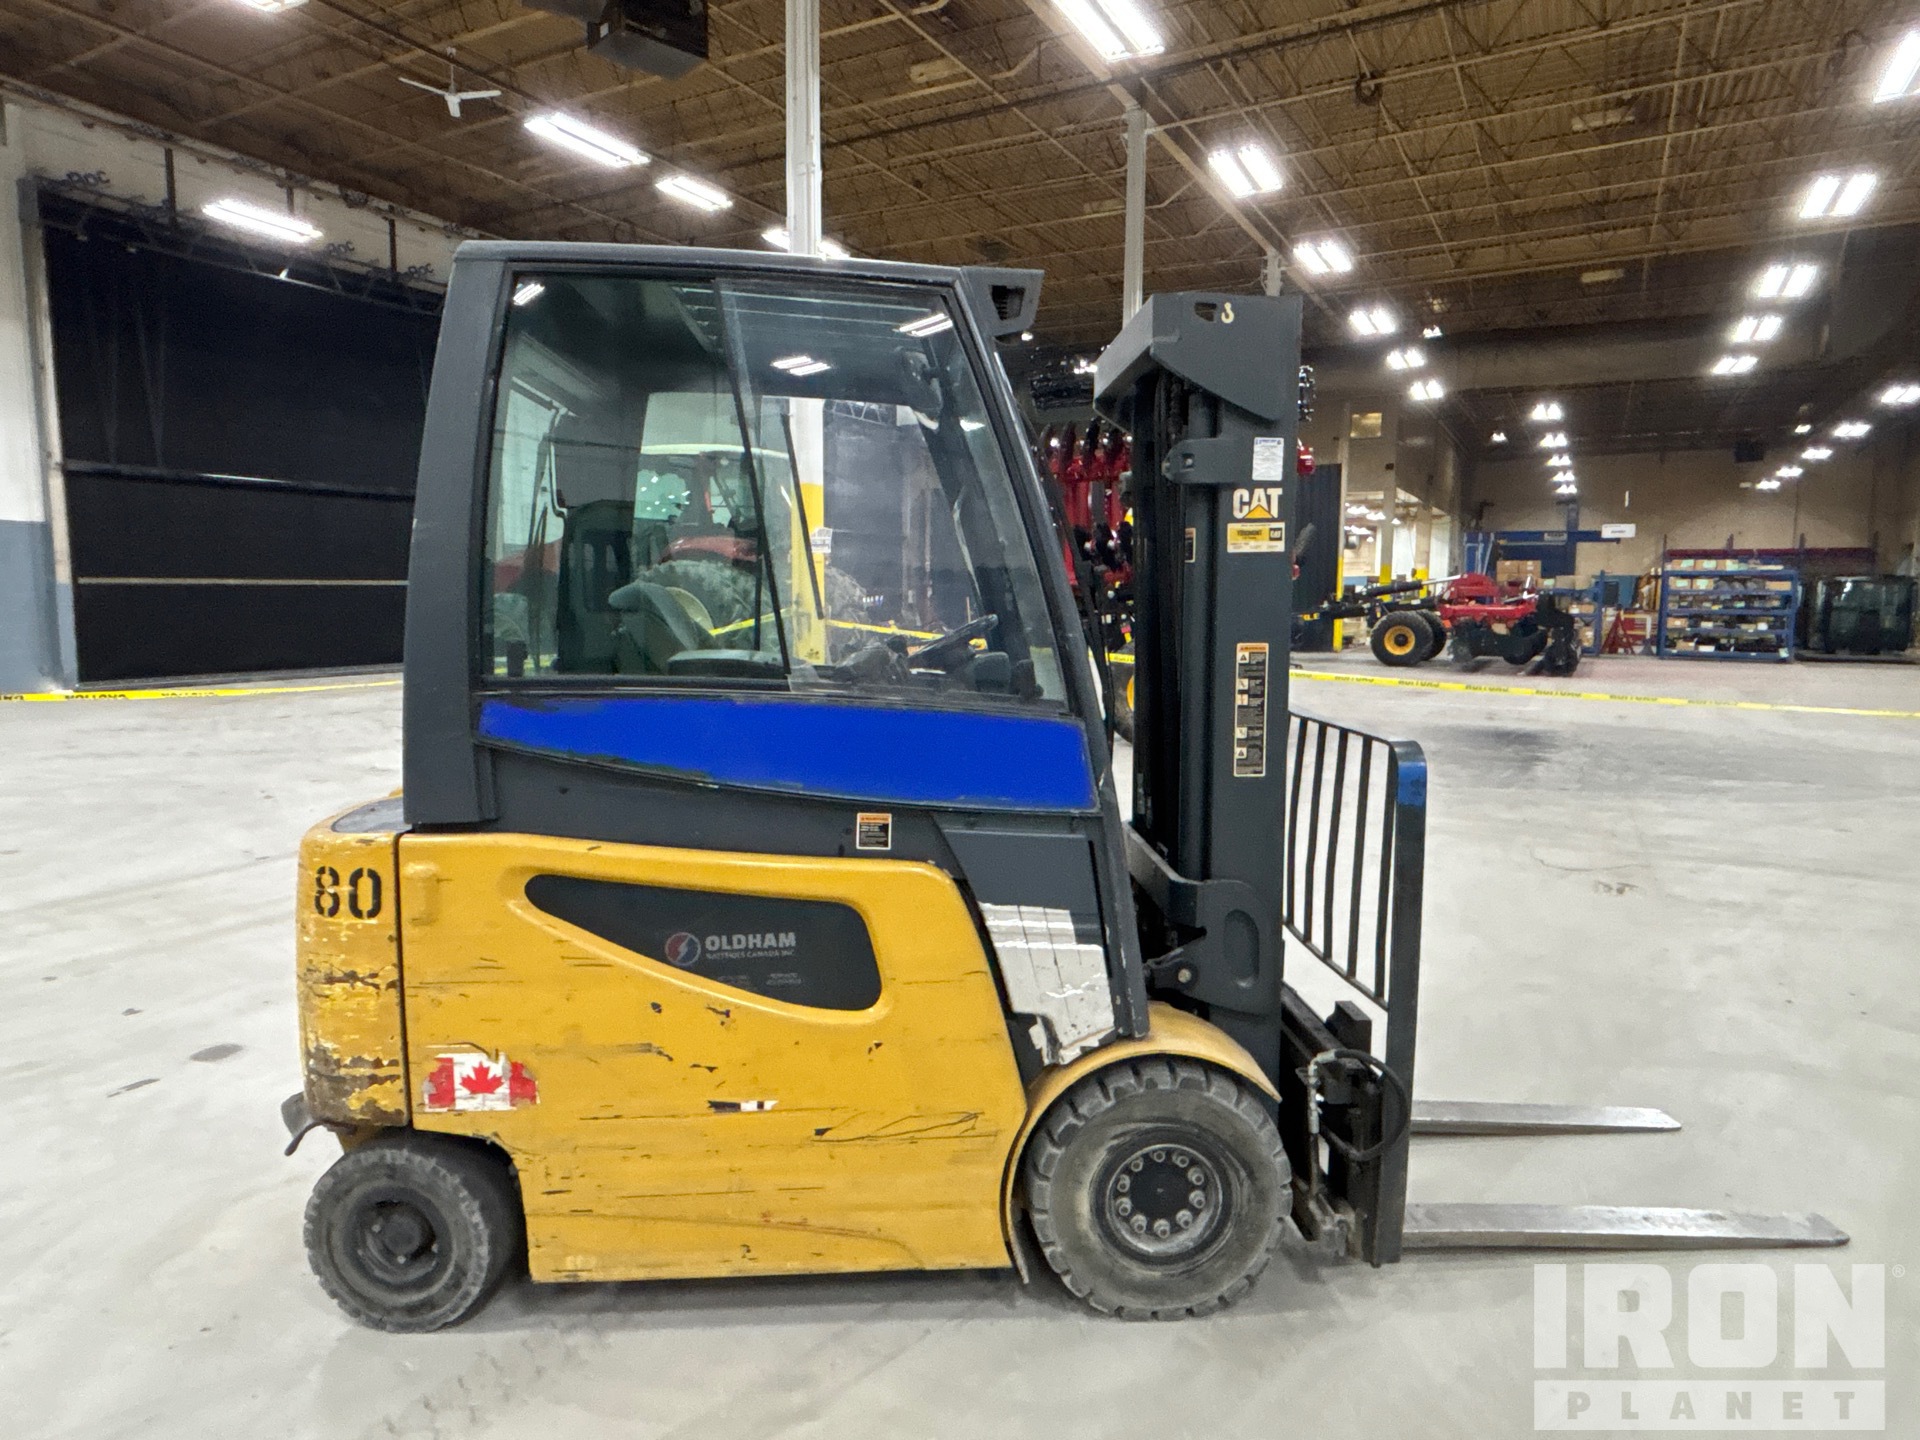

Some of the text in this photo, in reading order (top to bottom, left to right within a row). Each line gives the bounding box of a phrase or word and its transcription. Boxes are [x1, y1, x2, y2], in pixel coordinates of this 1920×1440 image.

[1233, 488, 1283, 519] CAT
[315, 866, 382, 919] 80
[705, 932, 796, 950] OLDHAM
